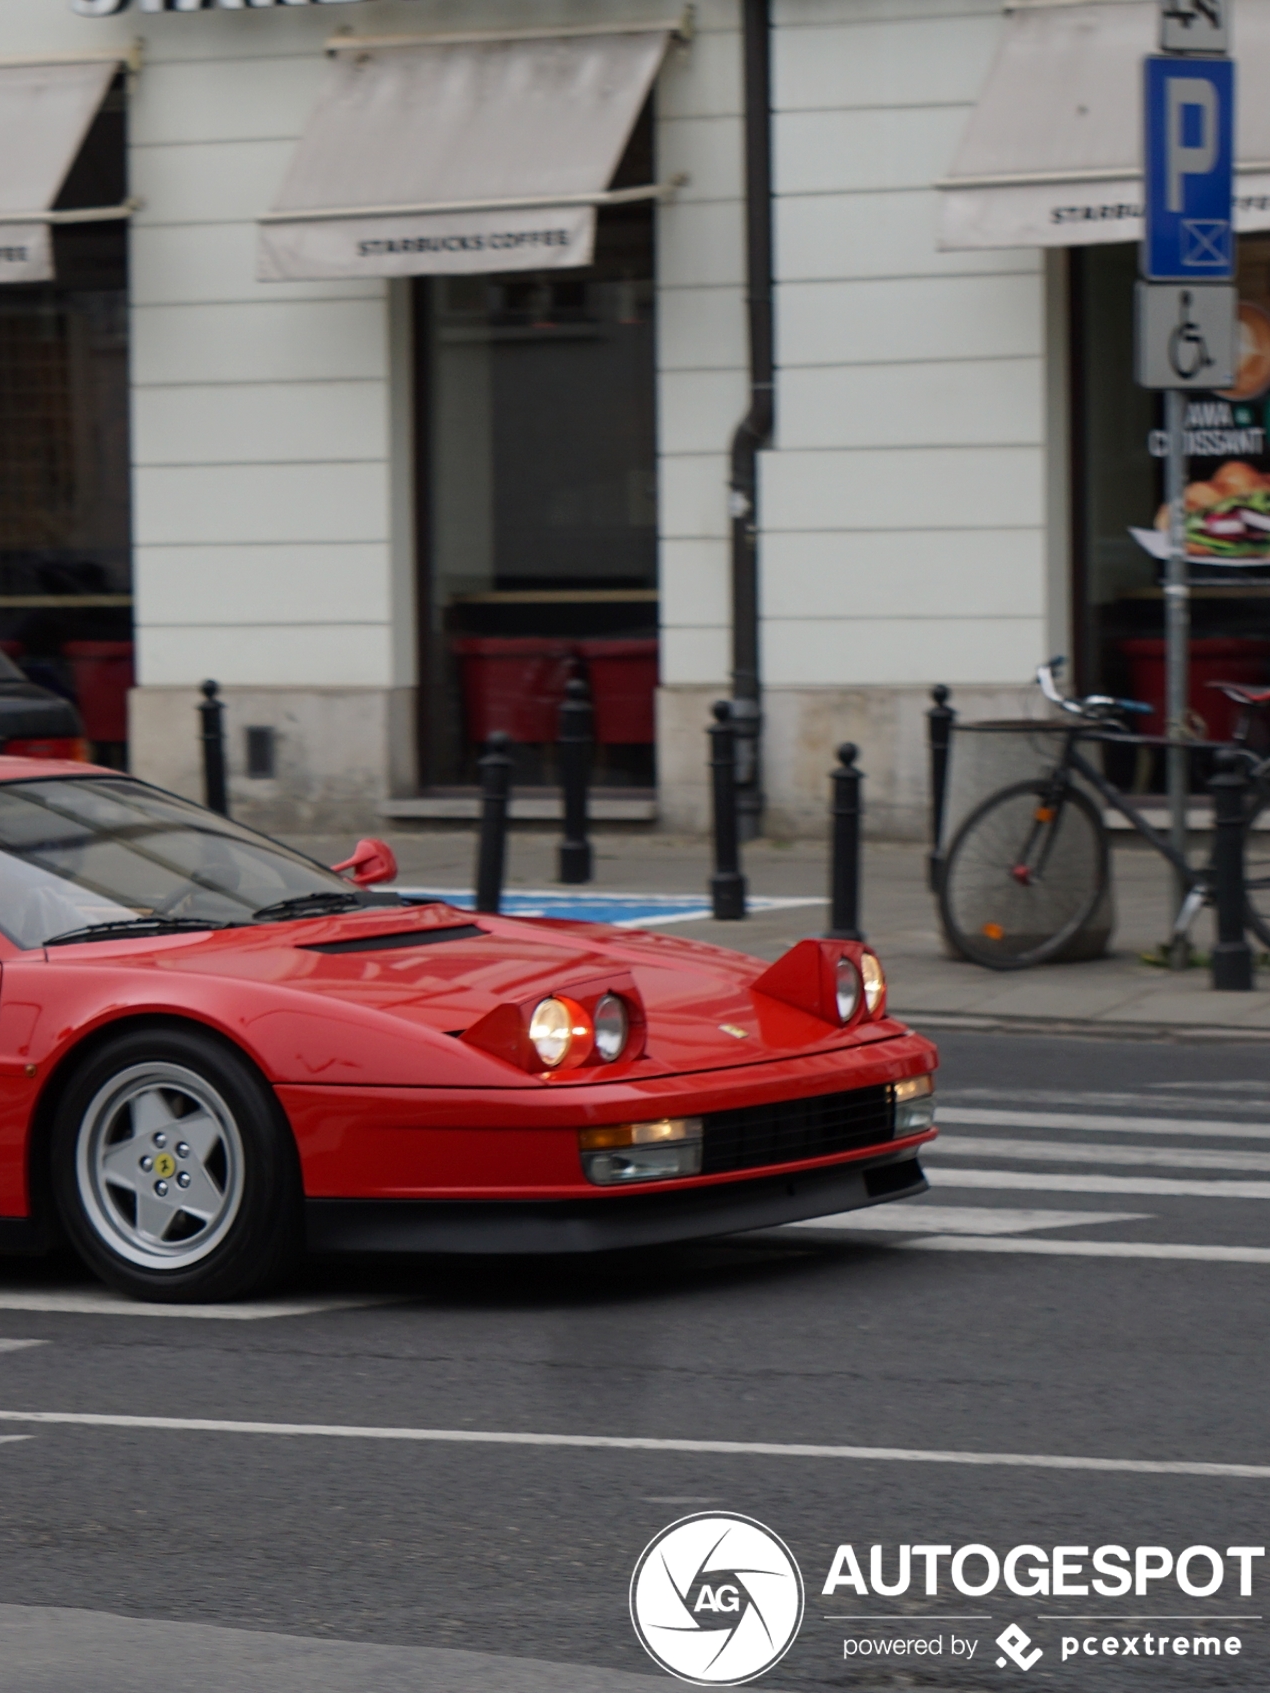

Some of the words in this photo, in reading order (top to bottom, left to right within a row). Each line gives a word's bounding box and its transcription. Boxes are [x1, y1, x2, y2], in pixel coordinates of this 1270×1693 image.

[1164, 76, 1220, 213] P
[1050, 203, 1144, 224] STARBU
[358, 235, 483, 257] STARBUCKS
[489, 229, 570, 249] COFFEE
